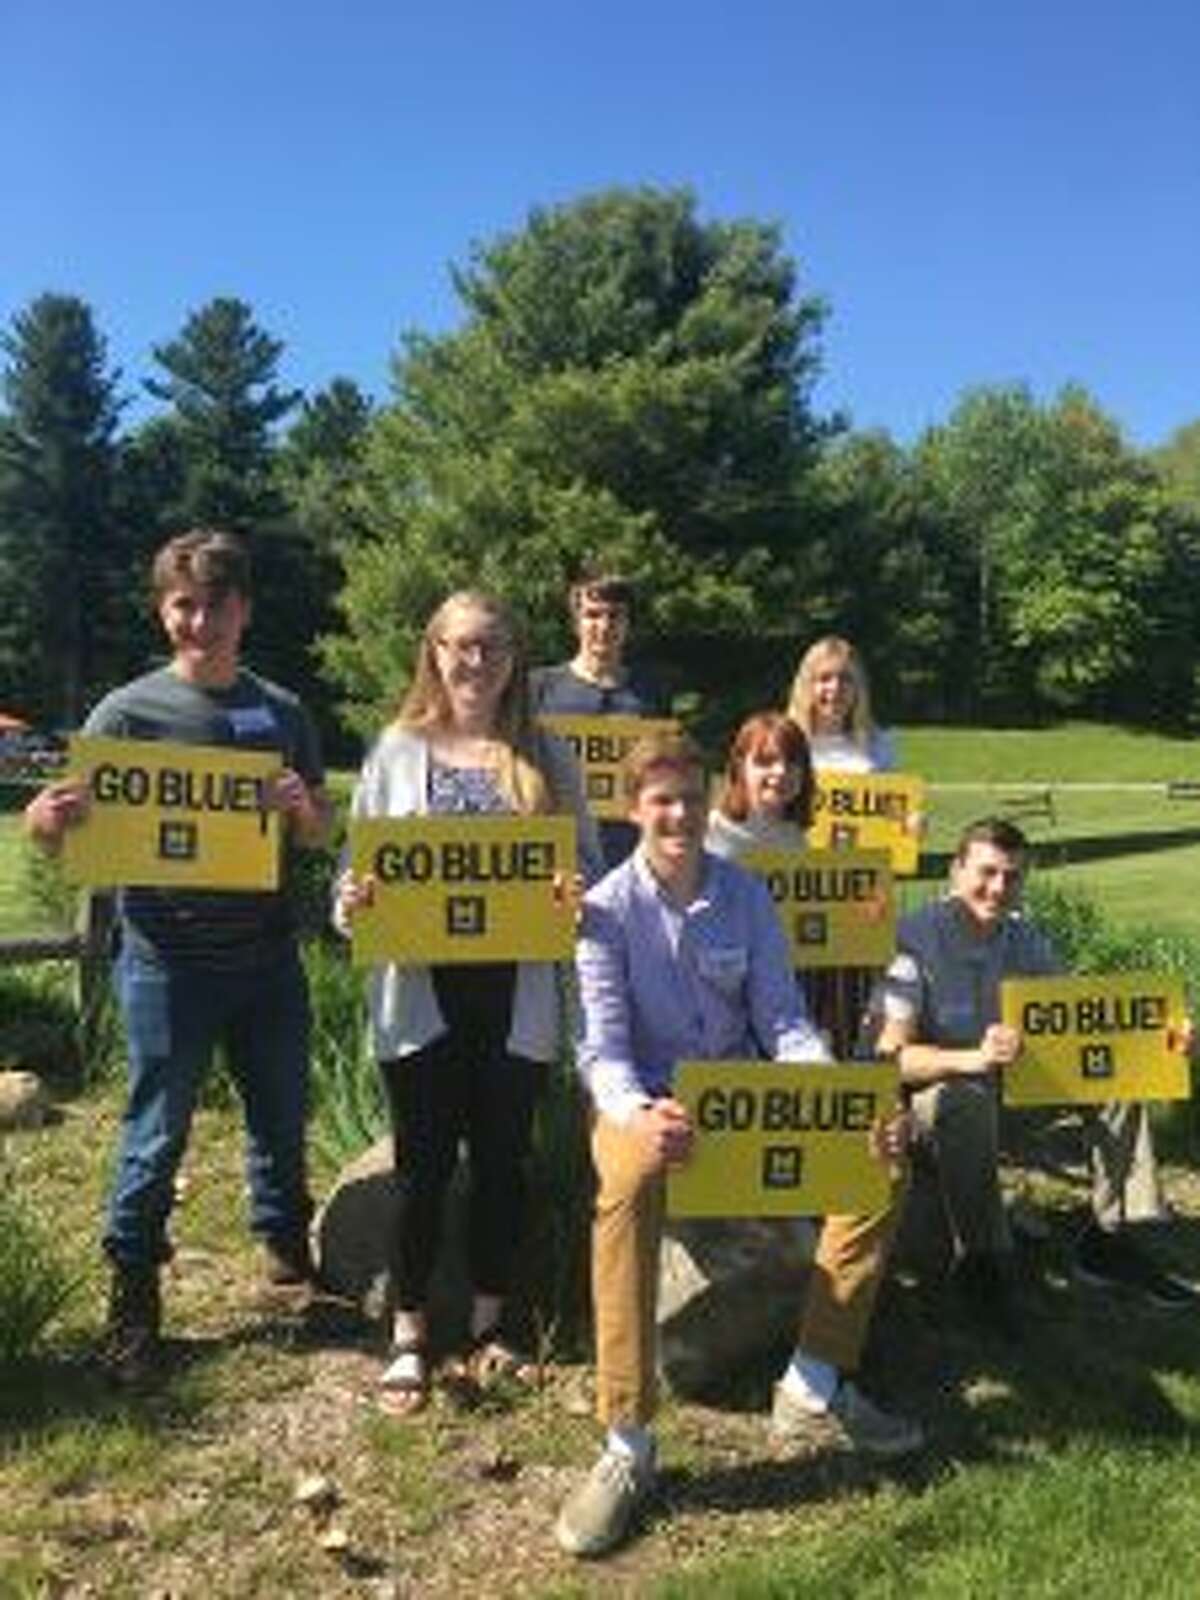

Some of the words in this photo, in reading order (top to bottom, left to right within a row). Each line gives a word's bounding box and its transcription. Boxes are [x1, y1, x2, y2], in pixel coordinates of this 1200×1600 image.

[92, 764, 150, 803] GO
[157, 769, 264, 812] BLUE!
[375, 842, 432, 882] GO
[441, 843, 555, 881] BLUE!
[1023, 1002, 1067, 1035] GO
[1076, 996, 1165, 1033] BLUE!
[697, 1091, 752, 1131] GO
[762, 1091, 875, 1131] BLUE!
